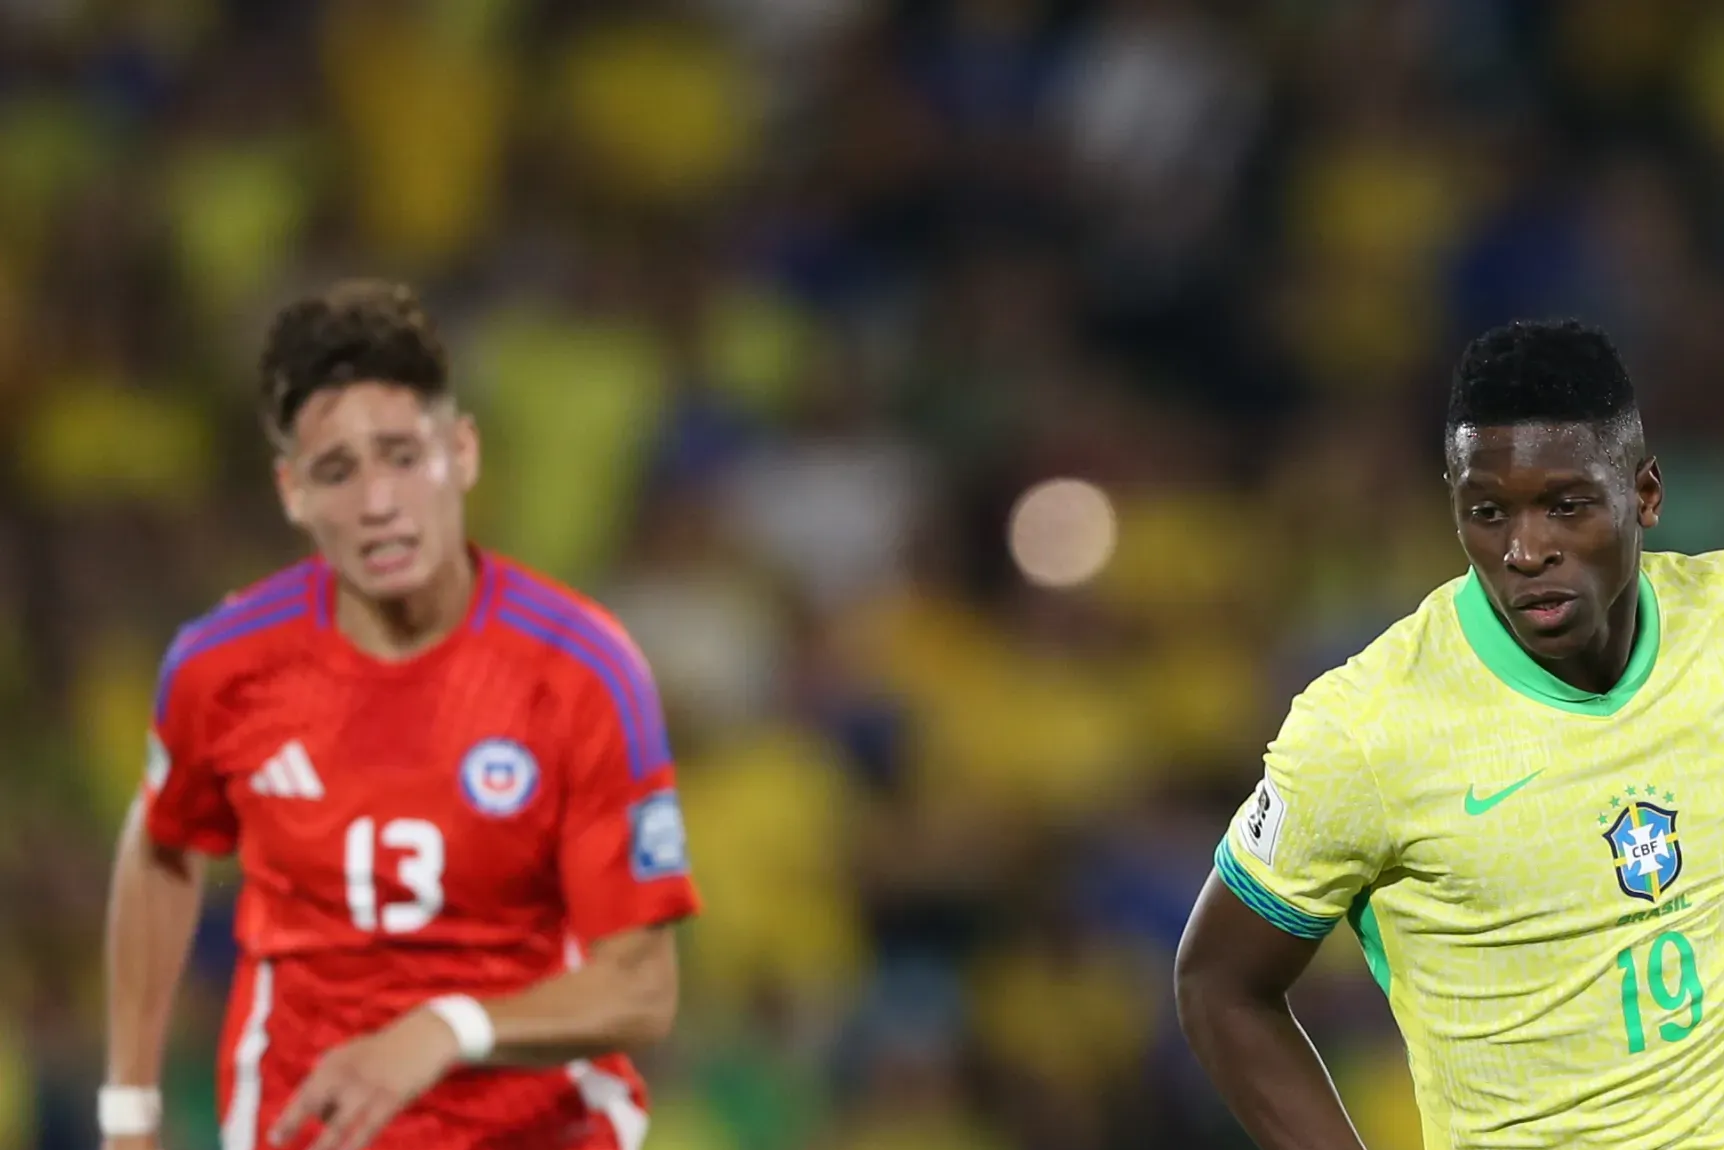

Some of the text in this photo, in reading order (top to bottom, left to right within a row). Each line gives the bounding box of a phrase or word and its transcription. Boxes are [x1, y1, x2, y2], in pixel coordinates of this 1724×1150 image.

[344, 815, 444, 935] 13
[1632, 839, 1659, 860] CBF
[1616, 893, 1693, 926] BRASIL
[1617, 930, 1704, 1055] 19
